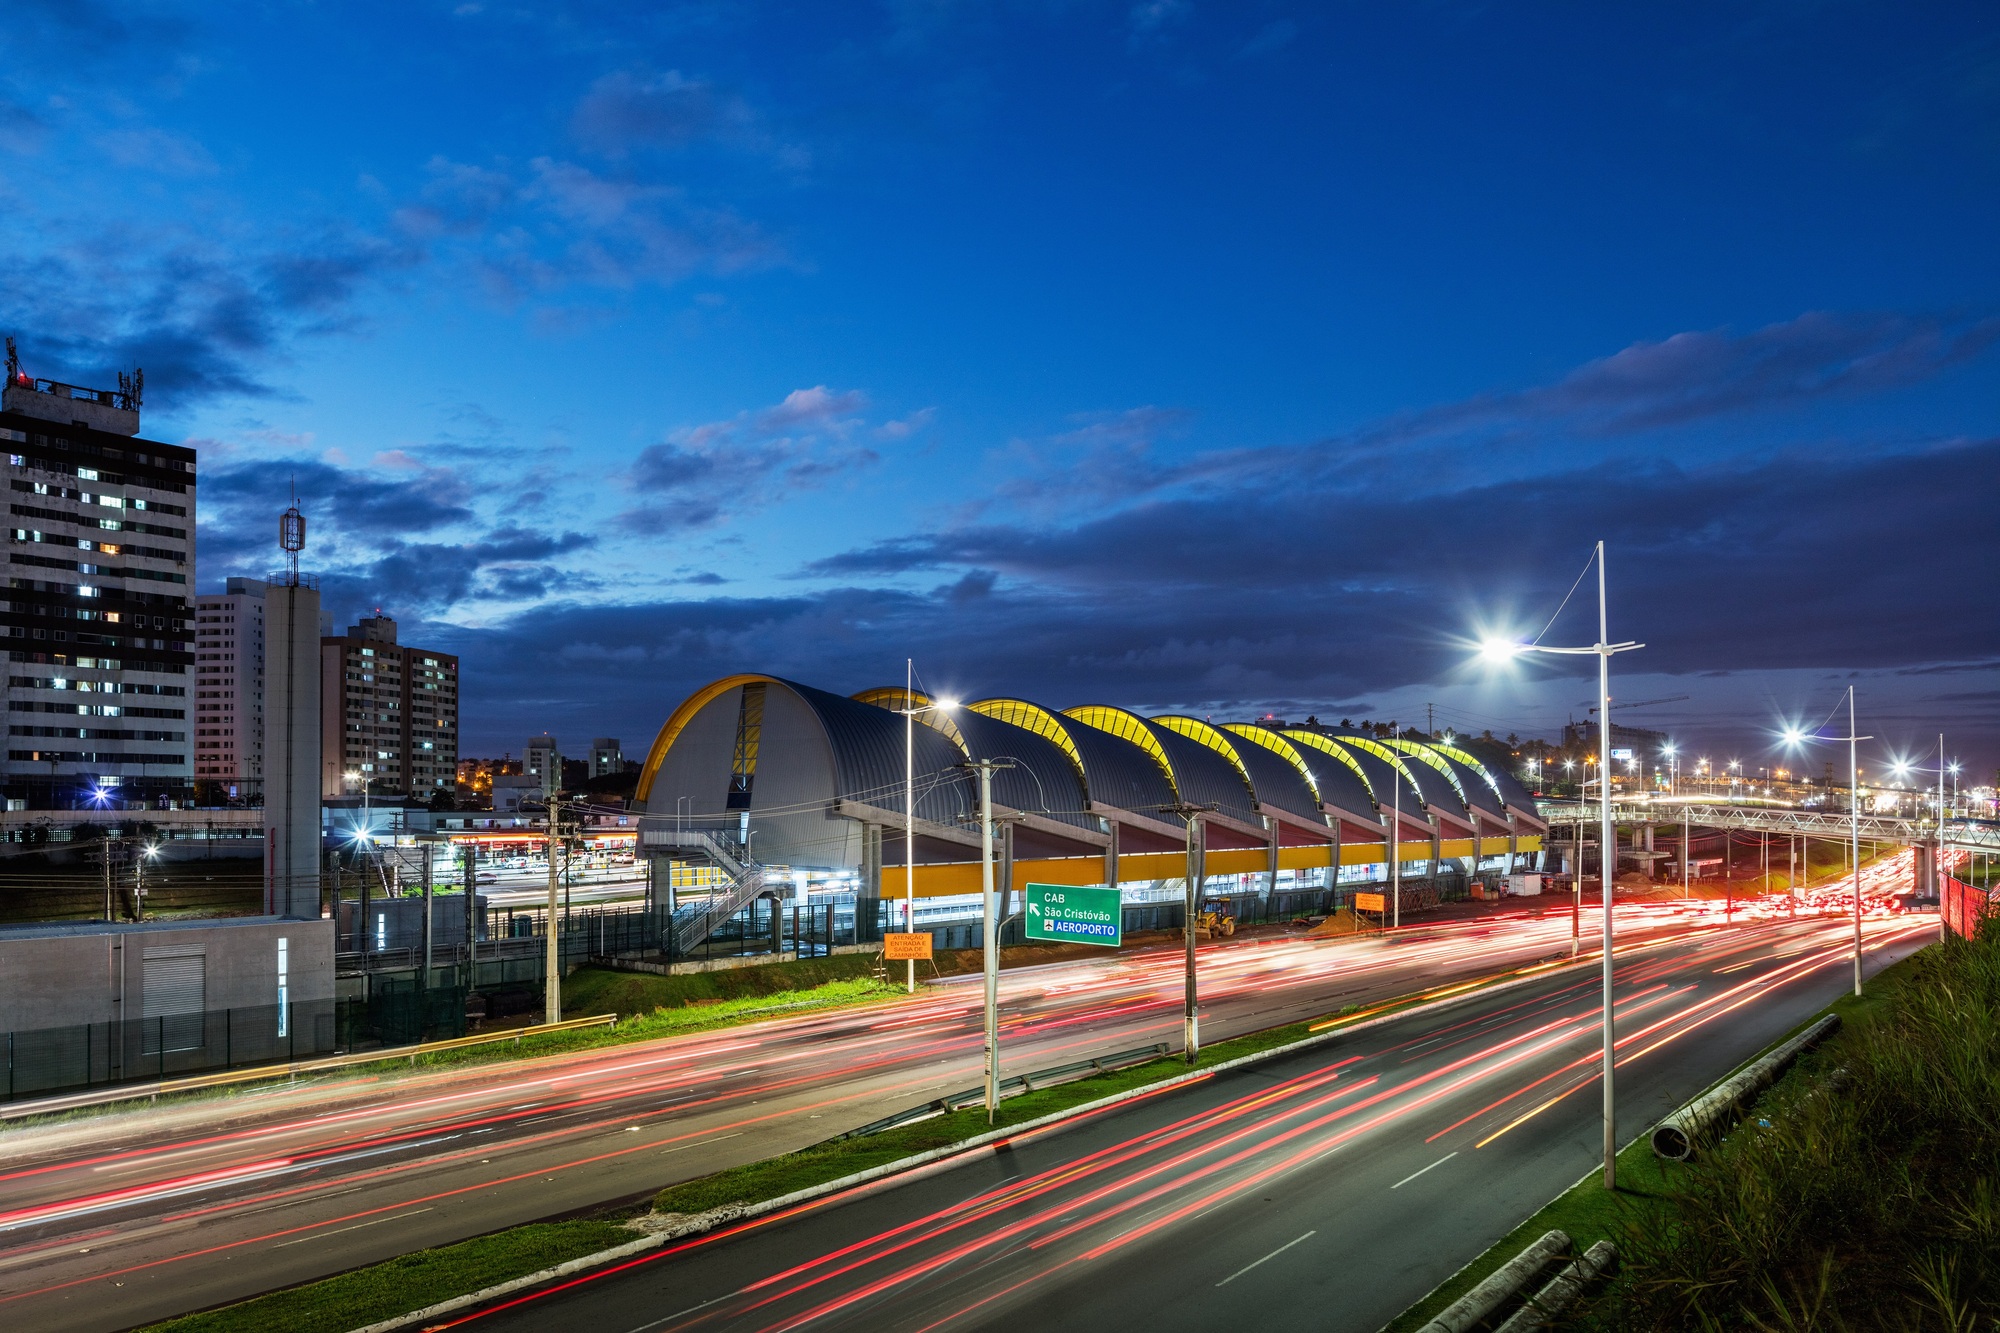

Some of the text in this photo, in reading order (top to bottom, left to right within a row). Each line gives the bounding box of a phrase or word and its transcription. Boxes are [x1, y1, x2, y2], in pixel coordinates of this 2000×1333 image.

[1044, 893, 1065, 903] CAB
[1044, 906, 1110, 921] São Cristóvão
[1056, 922, 1115, 936] AEROPORTO
